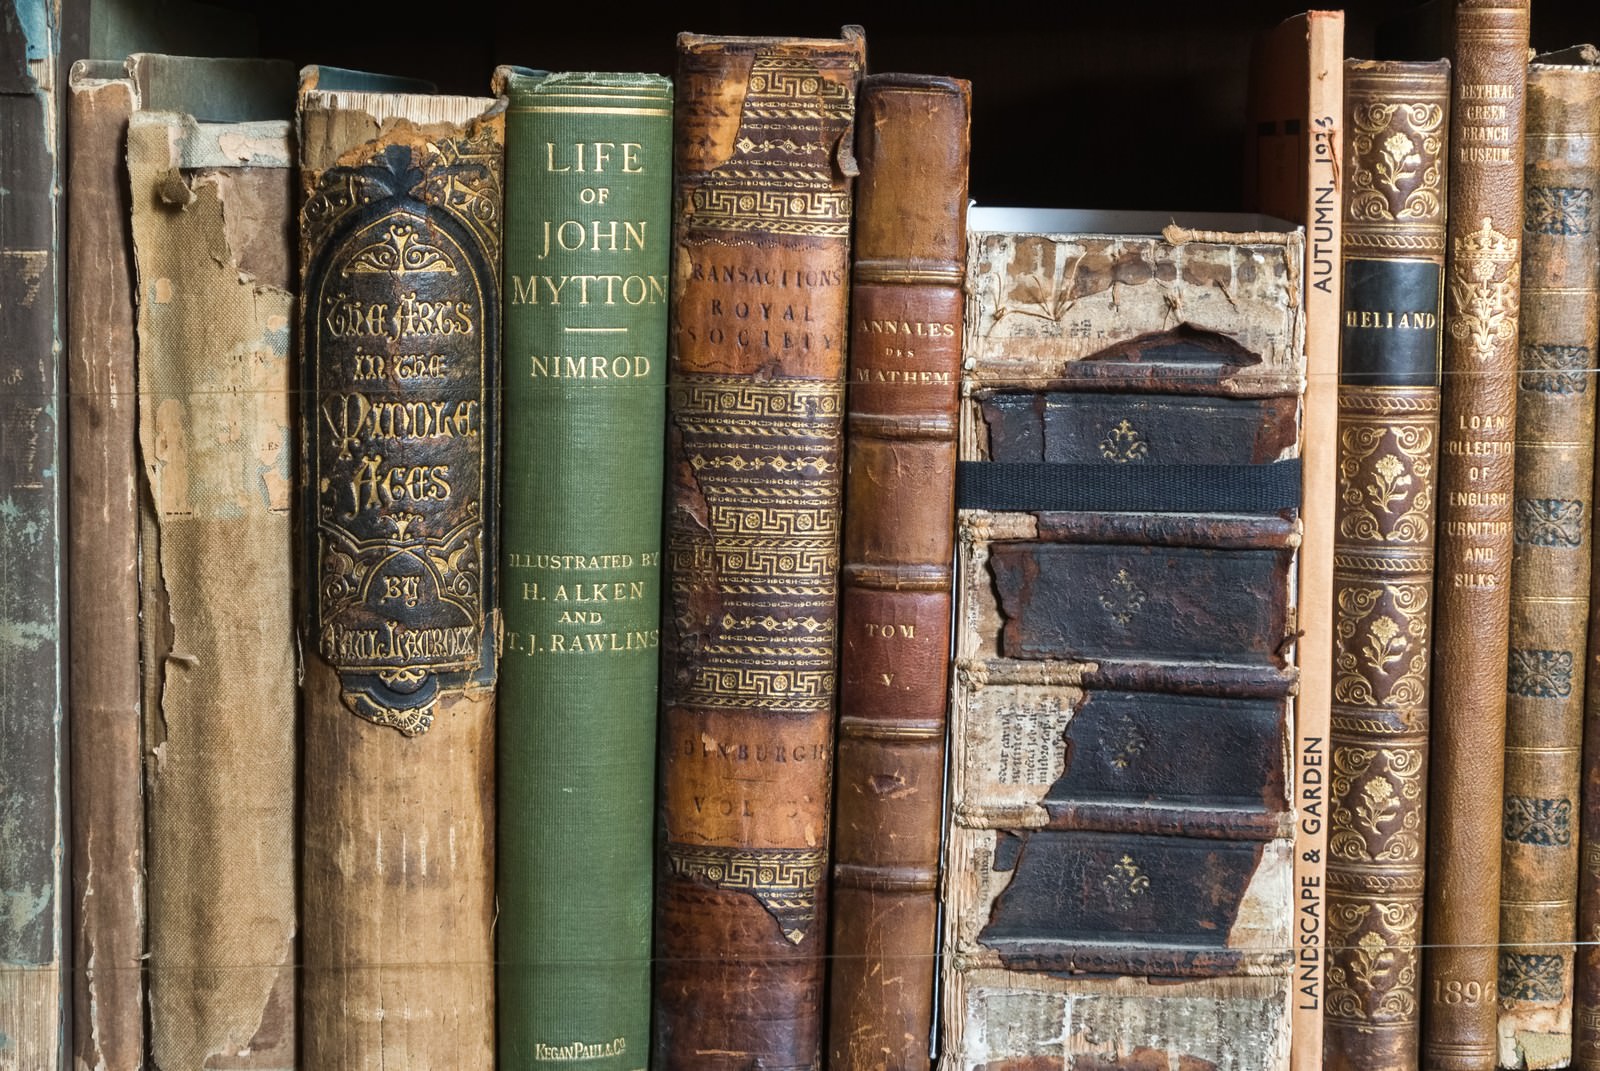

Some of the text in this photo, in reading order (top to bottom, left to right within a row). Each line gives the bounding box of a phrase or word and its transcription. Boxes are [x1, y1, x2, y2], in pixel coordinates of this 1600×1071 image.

[1461, 84, 1515, 99] BETHNAL
[1467, 105, 1506, 120] GREEN
[1463, 126, 1509, 141] BRANCH
[546, 142, 643, 173] LIFE
[579, 187, 610, 204] OF
[538, 220, 648, 260] JOHN
[691, 263, 842, 288] RANSACTIONS
[511, 274, 668, 305] MYTTON
[710, 299, 815, 322] ROYAL
[1345, 310, 1436, 330] HELIAND
[687, 326, 835, 350] SOCIETY
[859, 319, 955, 337] ANNALES
[885, 347, 915, 358] DES
[530, 355, 651, 379] NIMROD
[1459, 415, 1506, 430] LOAN
[1469, 466, 1491, 481] OF
[1449, 491, 1507, 507] ENGLISH
[508, 552, 660, 569] ILLUSTRATED BY
[1464, 547, 1495, 562] AND
[522, 581, 645, 601] H. ALKEN
[557, 611, 603, 624] AND
[550, 630, 660, 652] RAWLINS
[683, 739, 826, 763] DINBURGH
[1299, 736, 1323, 1011] LANDSCAPE & GARDEN
[1433, 980, 1496, 1005] 1896
